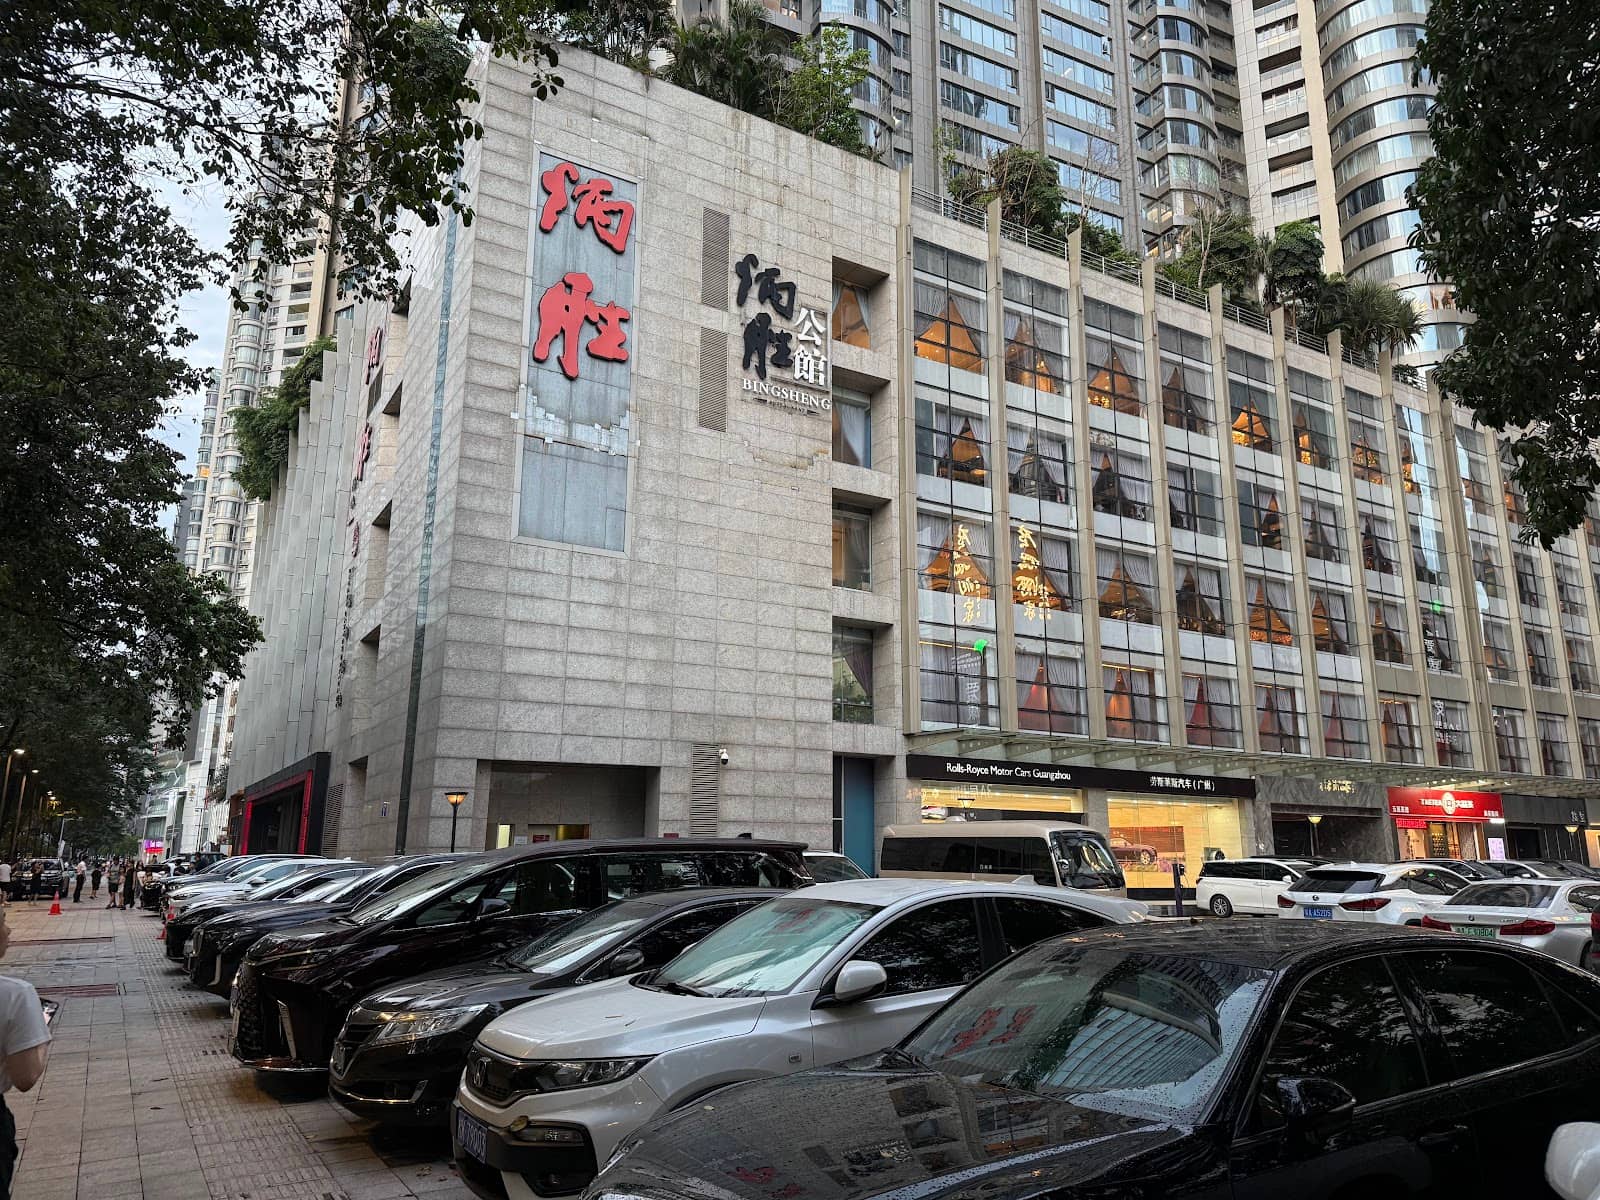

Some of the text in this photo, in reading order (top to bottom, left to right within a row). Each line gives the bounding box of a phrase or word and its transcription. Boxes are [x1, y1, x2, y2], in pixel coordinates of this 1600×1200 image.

[742, 378, 832, 410] BINGSHENG
[946, 762, 1071, 782] Rolls-Royce Motor Cars Guangzhou
